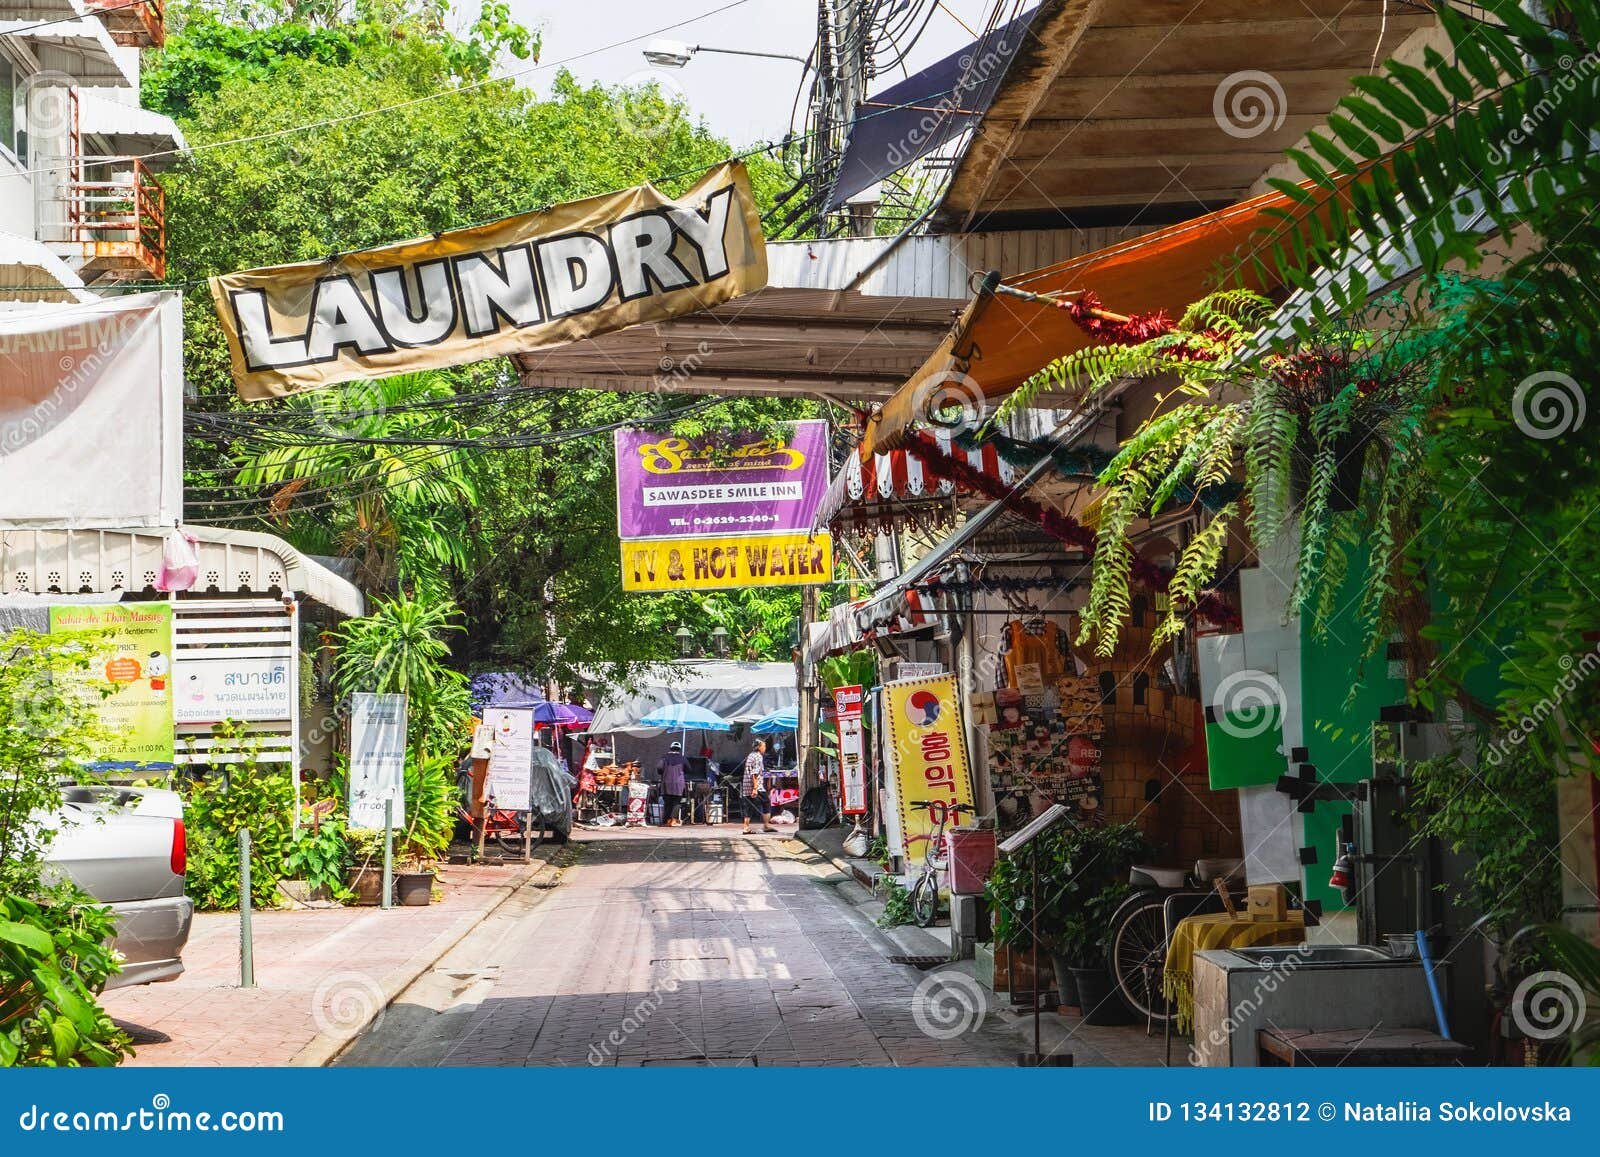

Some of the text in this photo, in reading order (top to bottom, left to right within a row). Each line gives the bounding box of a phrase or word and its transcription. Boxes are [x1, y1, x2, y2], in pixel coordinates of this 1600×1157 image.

[229, 182, 735, 372] LAUNDRY
[638, 437, 803, 474] Sadee
[649, 485, 797, 502] SAWASDEE SMILE INN
[669, 518, 690, 526] TEL.
[631, 543, 824, 583] TV & HOT WATER
[104, 611, 126, 624] Thai
[125, 627, 158, 635] Gentlemen
[117, 643, 139, 651] PRICE
[225, 666, 285, 685] สบายดี
